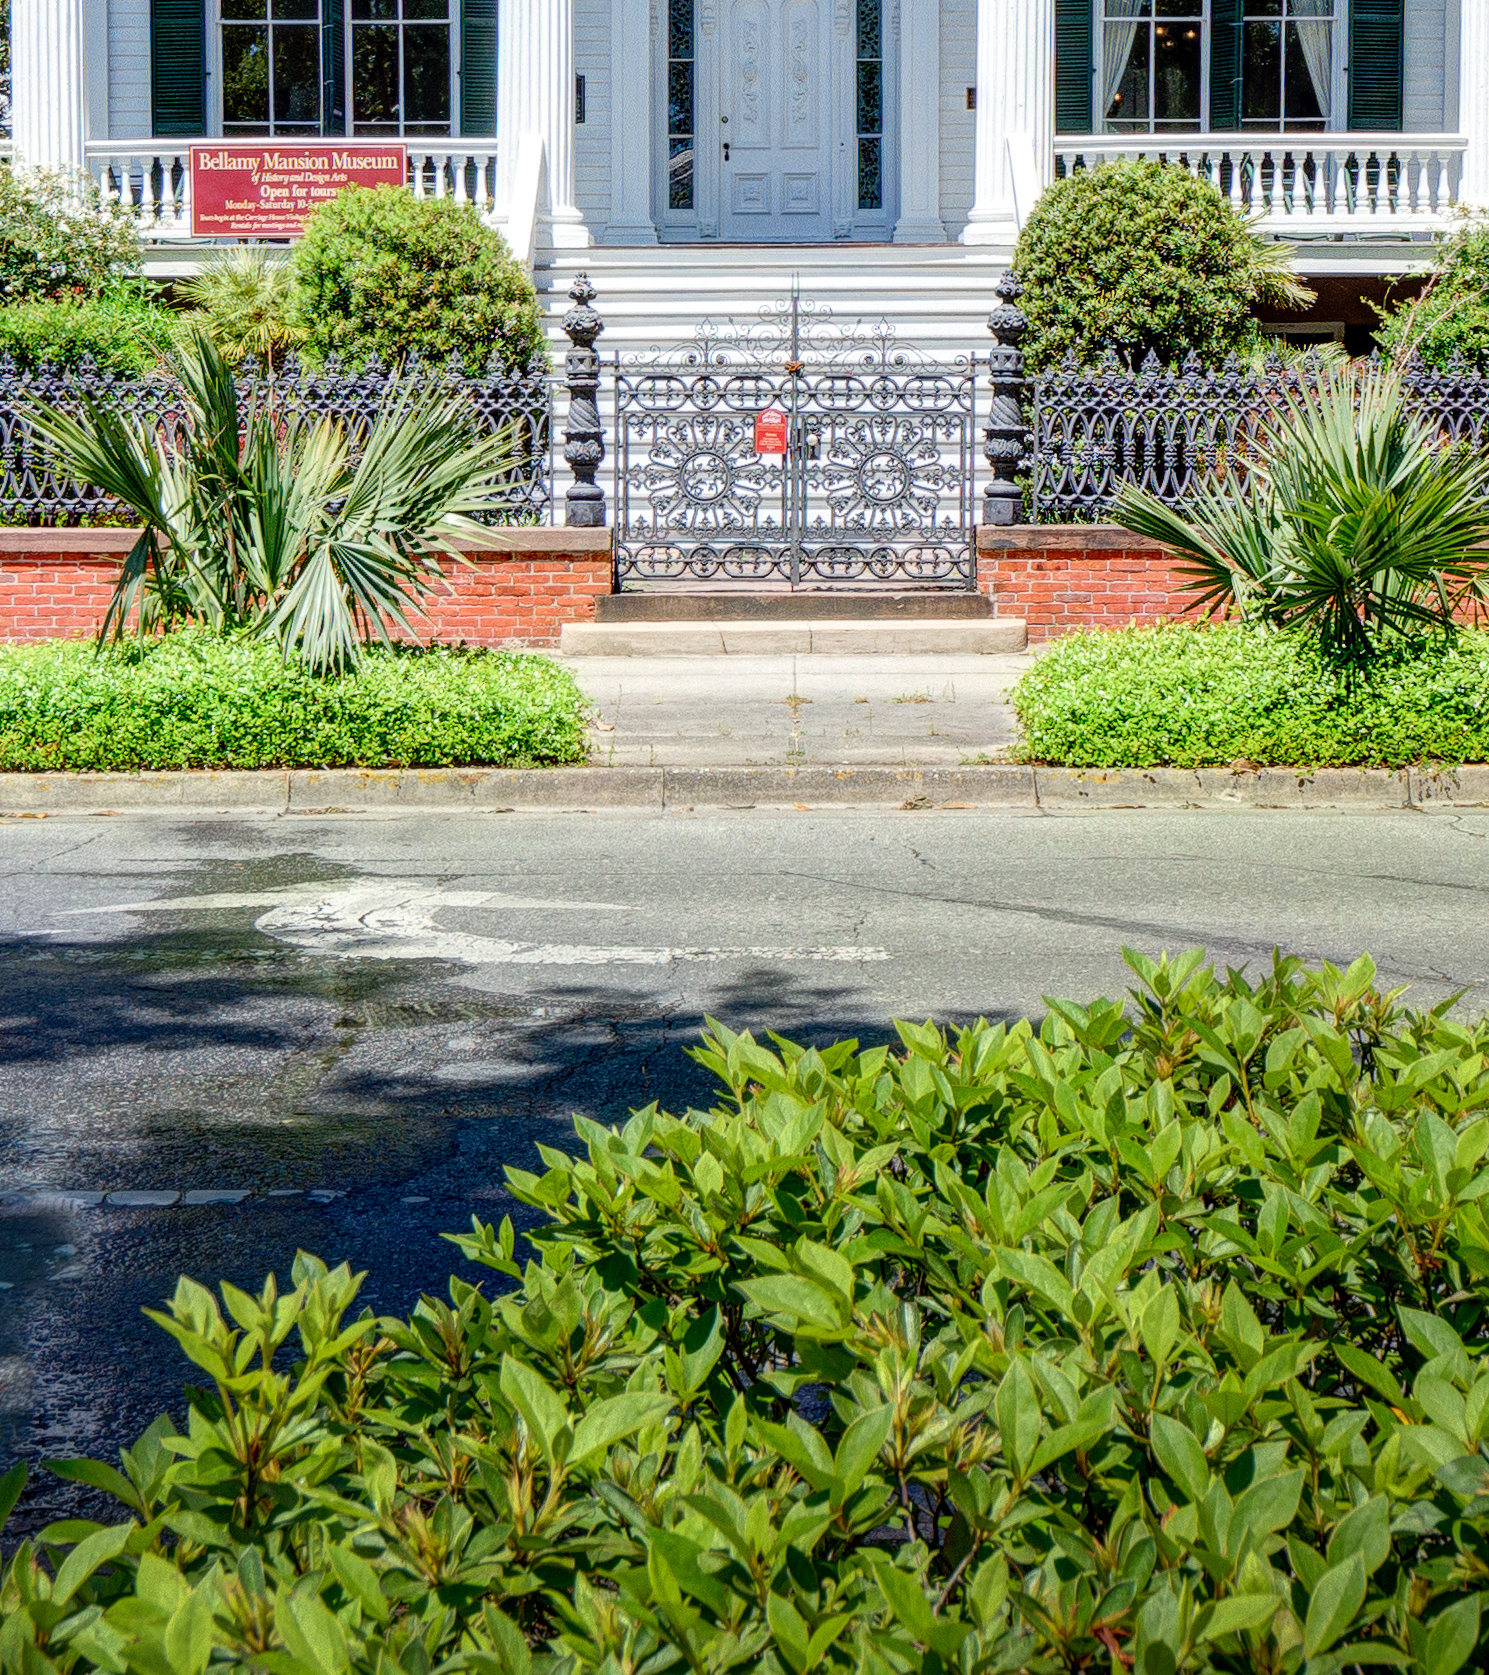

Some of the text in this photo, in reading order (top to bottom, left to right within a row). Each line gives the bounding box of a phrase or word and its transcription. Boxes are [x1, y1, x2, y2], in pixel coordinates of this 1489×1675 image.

[199, 151, 399, 176] Bellamy Mansion Museum
[251, 172, 348, 186] of History and Design Arts
[260, 184, 337, 201] Open for tours
[225, 198, 295, 211] Monday-Saturday
